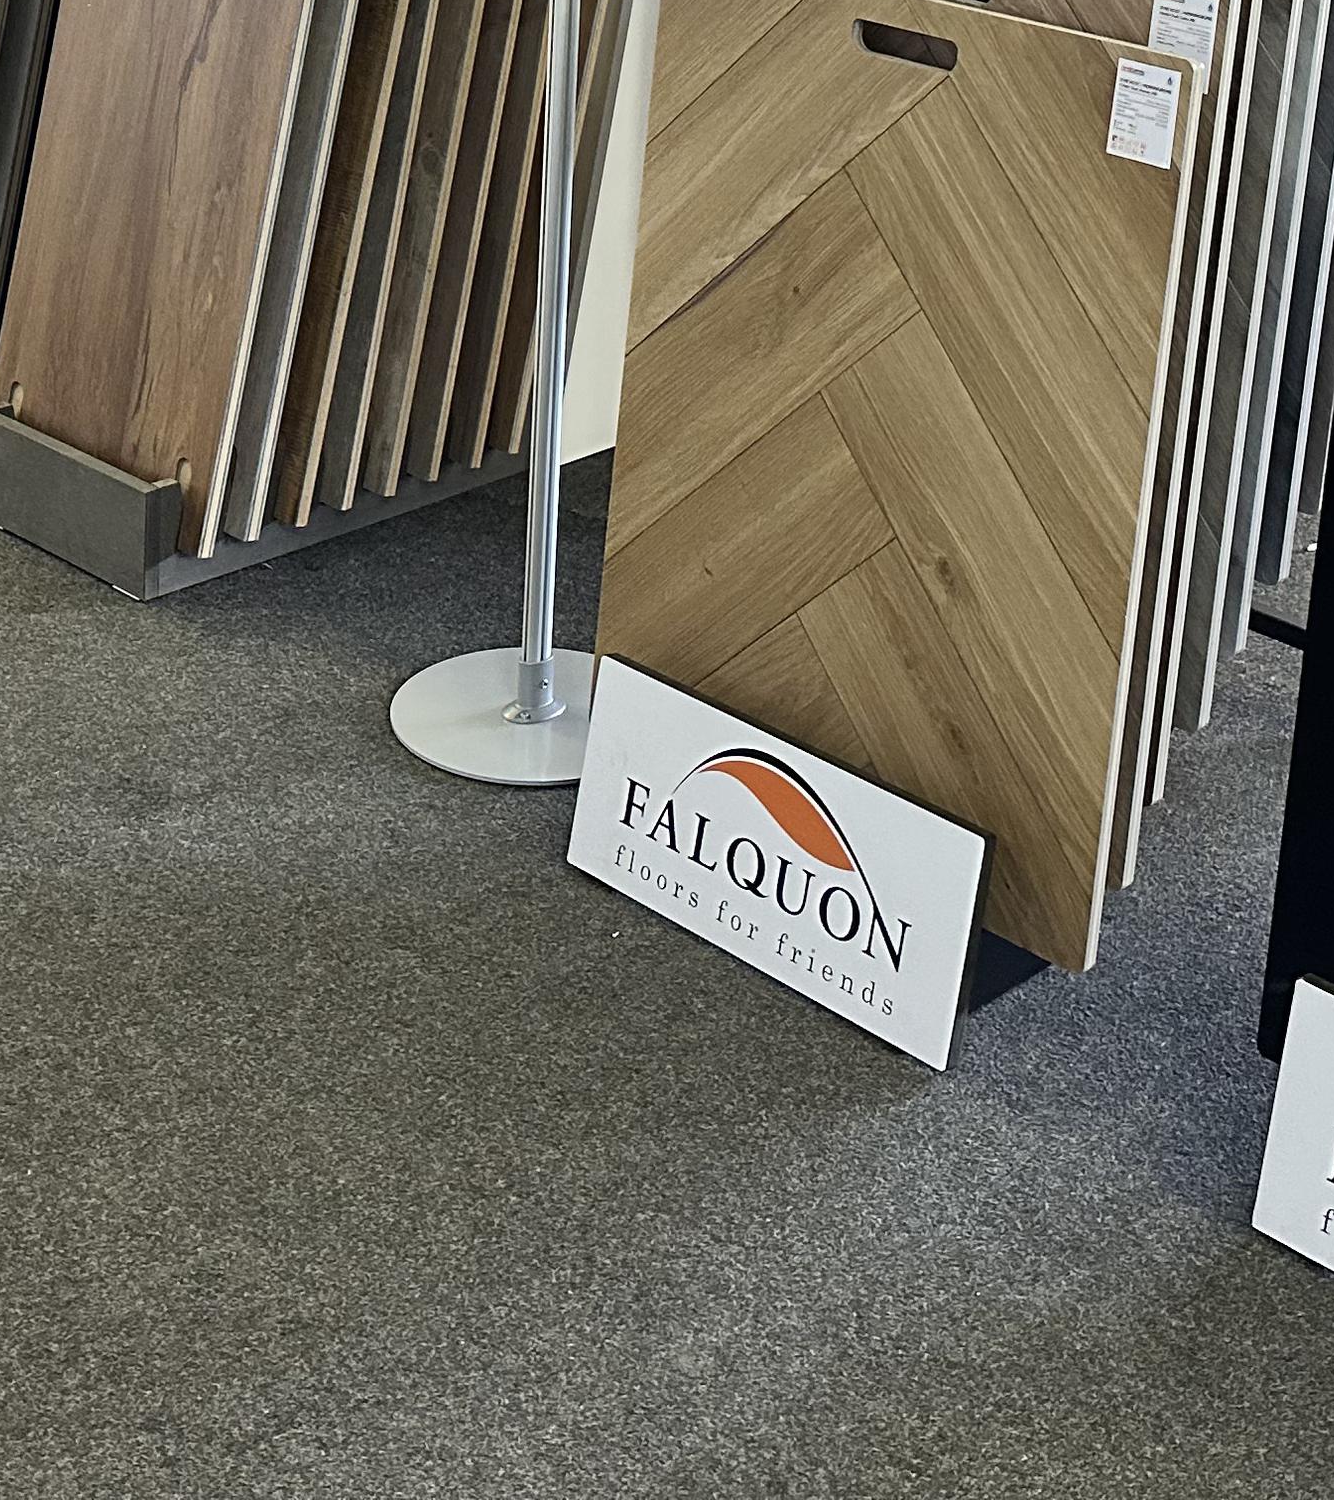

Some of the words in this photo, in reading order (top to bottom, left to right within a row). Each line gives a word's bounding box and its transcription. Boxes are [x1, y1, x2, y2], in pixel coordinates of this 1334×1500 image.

[614, 844, 700, 909] floors
[715, 900, 760, 941] for
[776, 934, 895, 1016] friends
[618, 776, 913, 973] FALQUON
